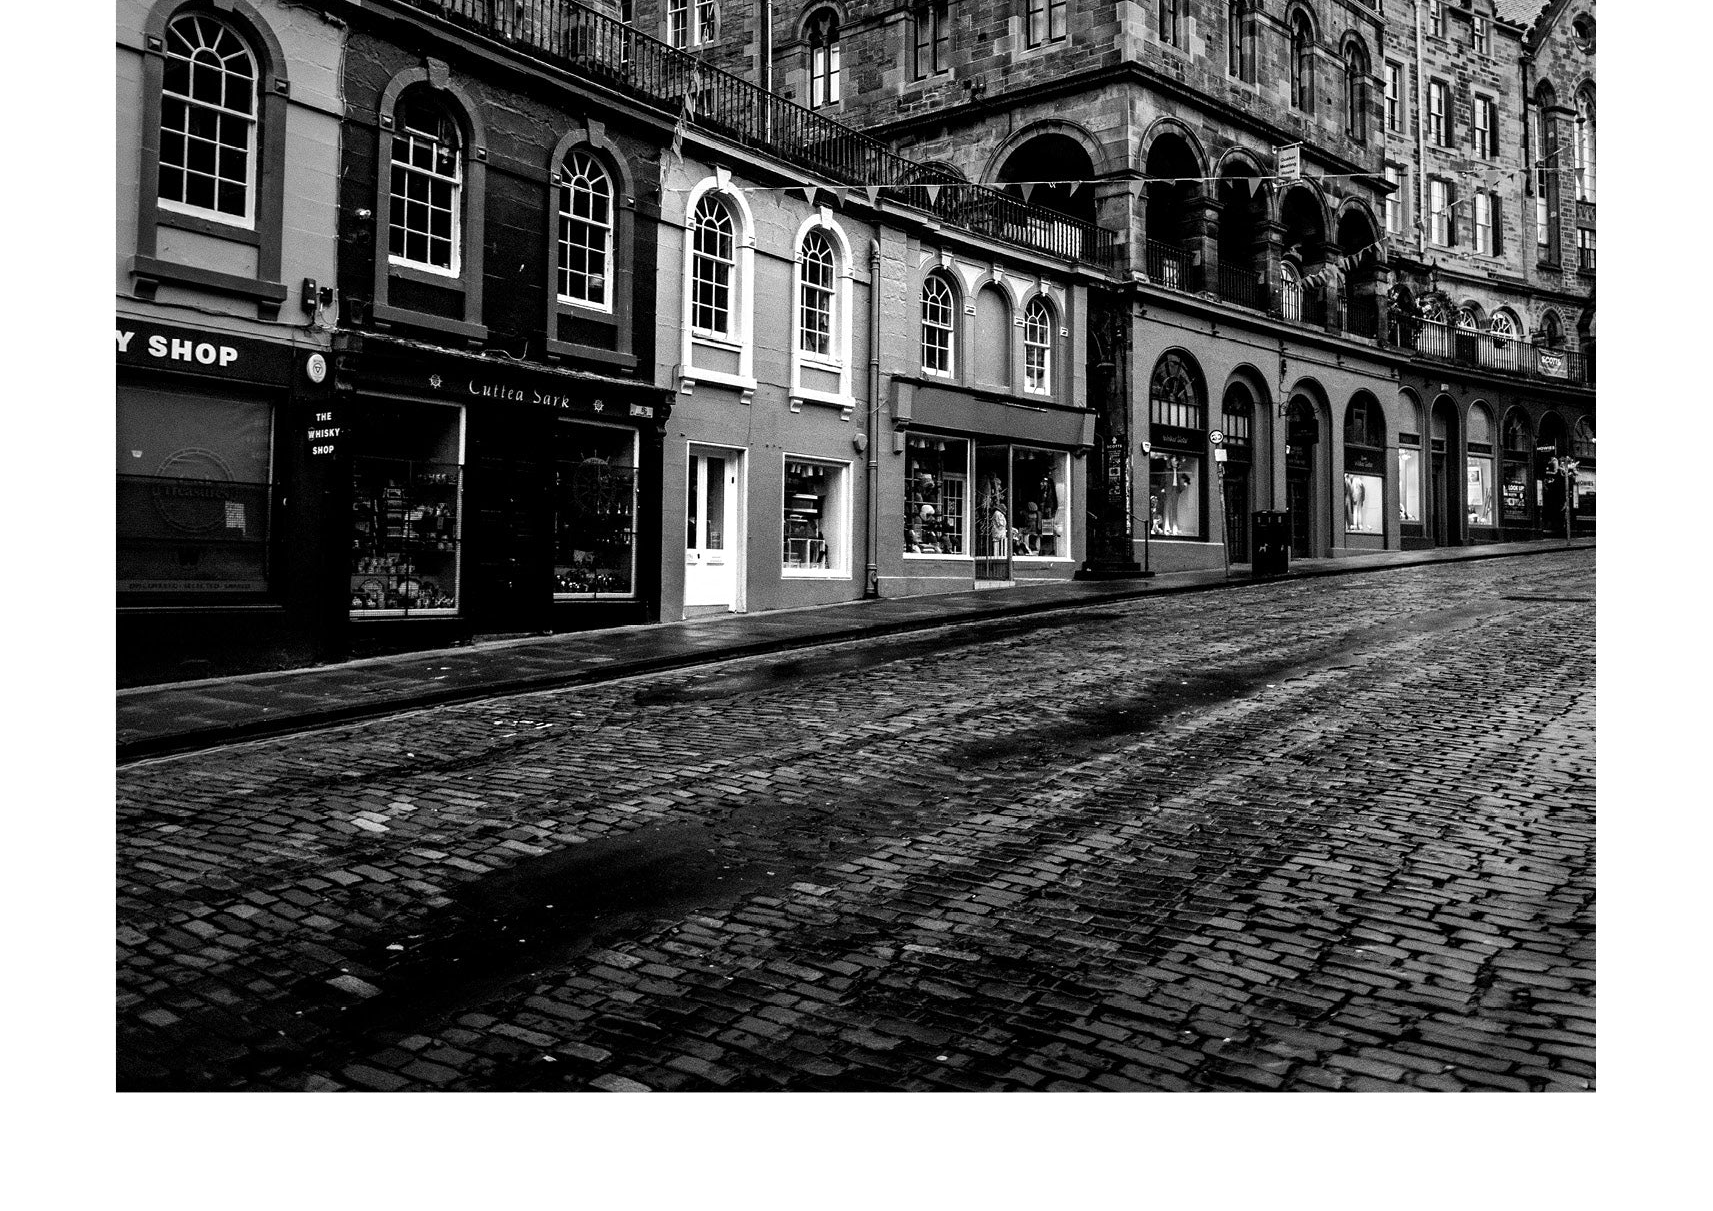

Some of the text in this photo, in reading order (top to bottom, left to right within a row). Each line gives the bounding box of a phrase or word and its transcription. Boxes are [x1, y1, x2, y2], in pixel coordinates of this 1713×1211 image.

[147, 335, 238, 367] SHOP
[468, 379, 570, 409] Cuttea Sark
[315, 411, 332, 422] THE
[307, 428, 341, 440] WHISKY
[312, 445, 335, 455] SHOP
